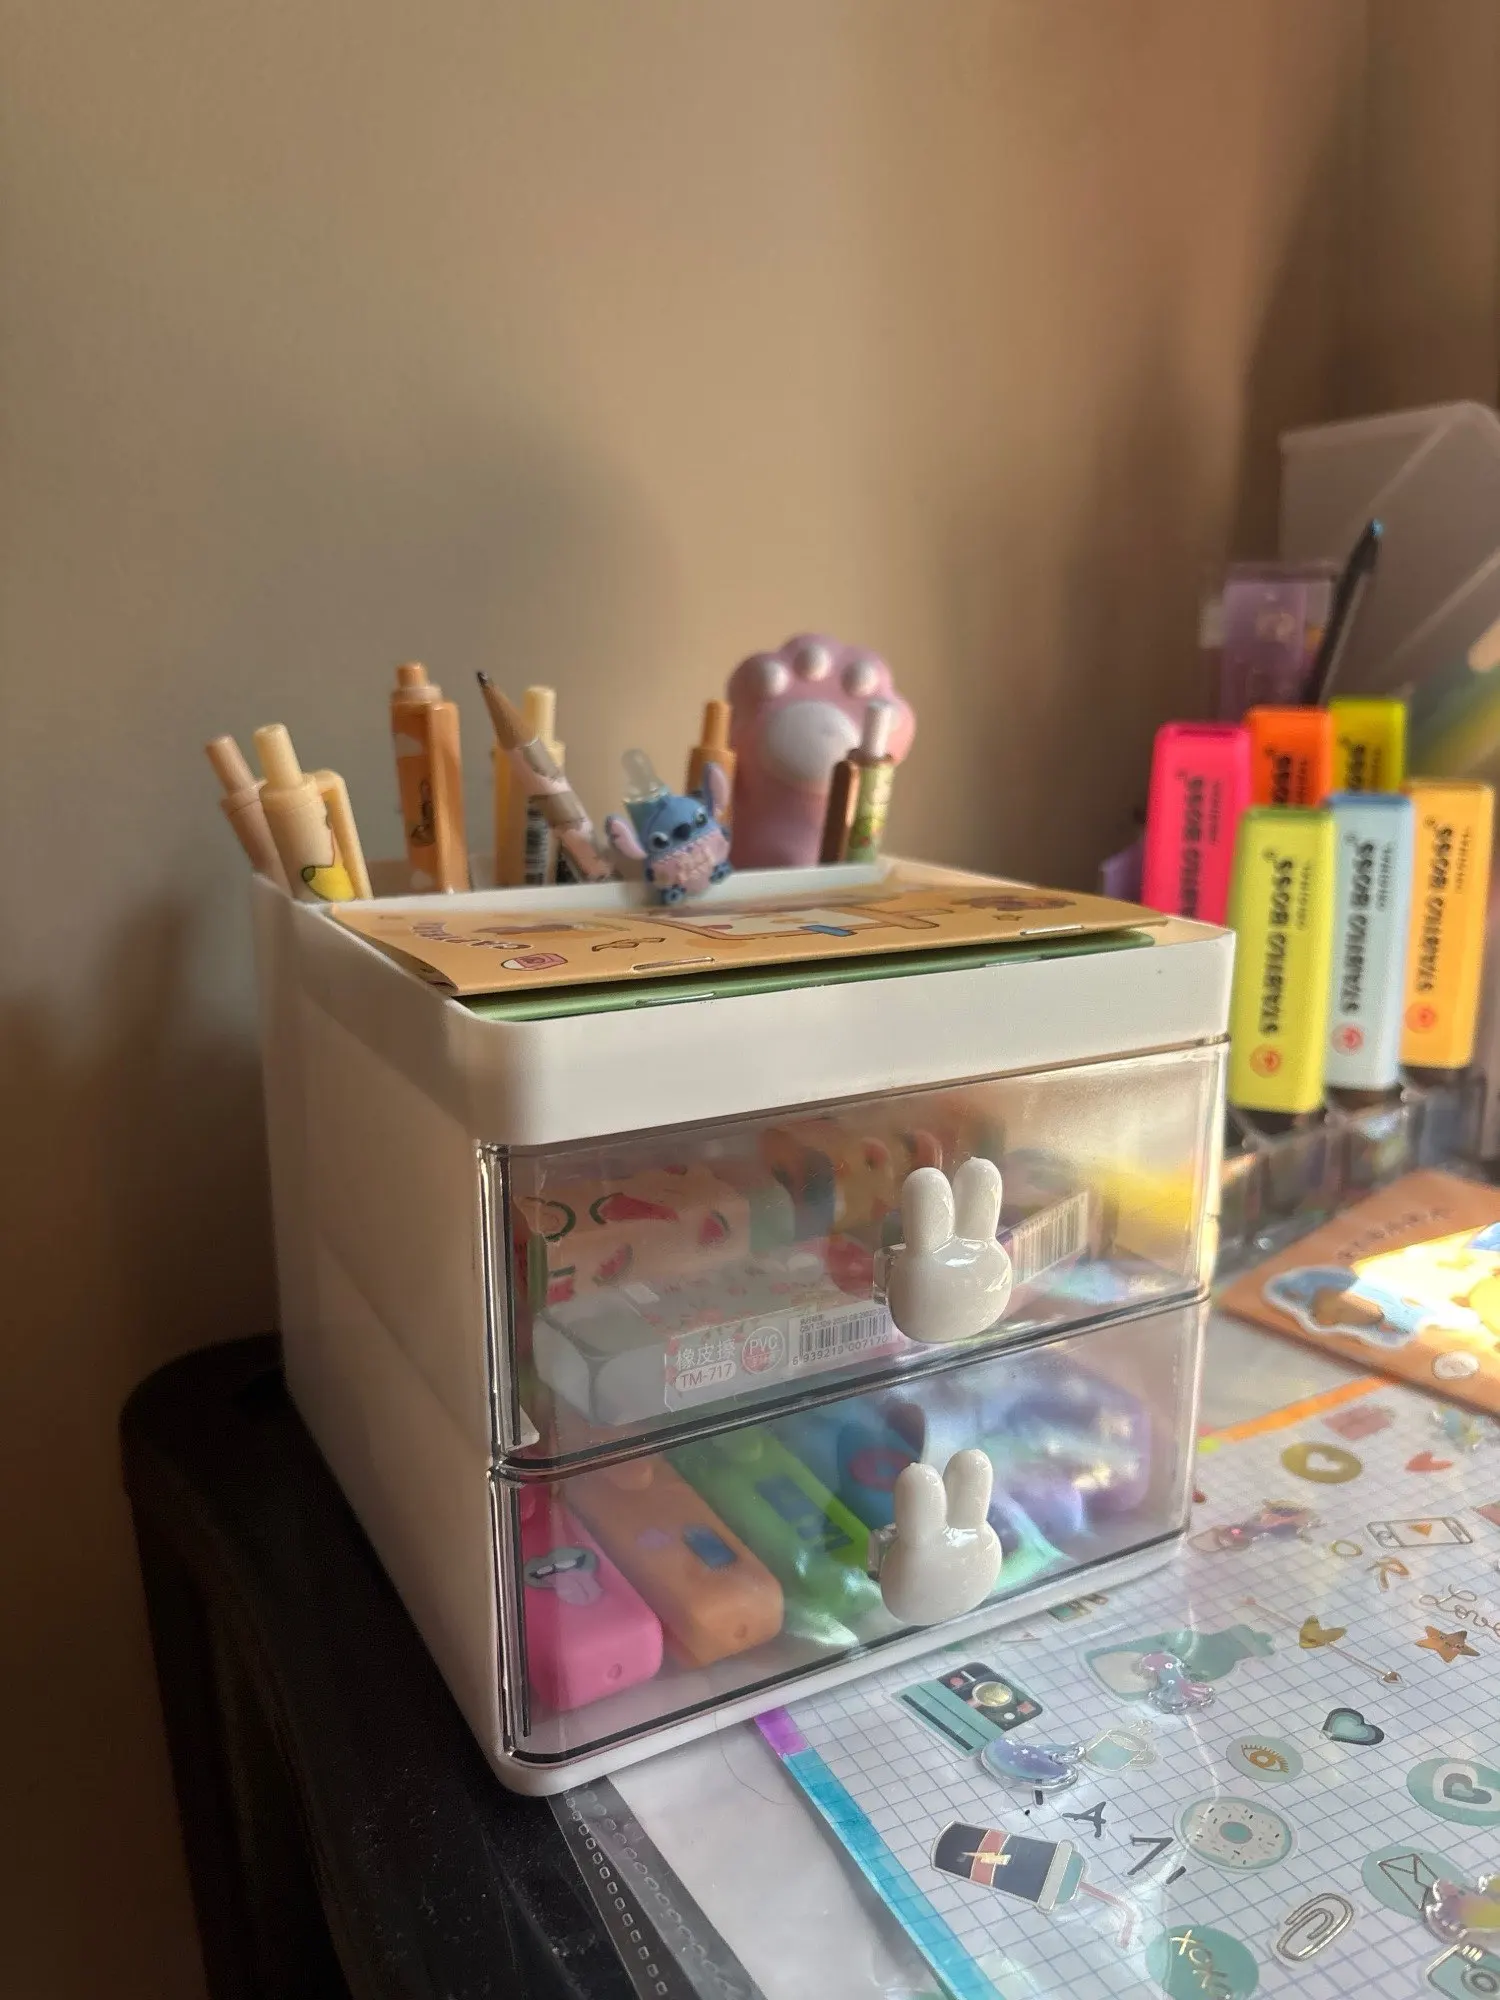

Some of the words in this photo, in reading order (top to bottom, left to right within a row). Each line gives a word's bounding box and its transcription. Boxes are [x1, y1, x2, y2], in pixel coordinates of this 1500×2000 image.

[1348, 841, 1374, 909] BOSS
[1427, 825, 1452, 890] BOSS
[1268, 859, 1293, 927] BOSS
[1340, 914, 1367, 1015] STABILO
[1415, 895, 1443, 993] STABILO
[1259, 931, 1287, 1035] STABILO
[676, 1337, 736, 1371] 橡皮擦
[682, 1362, 733, 1389] TM-717
[750, 1333, 778, 1355] PVC
